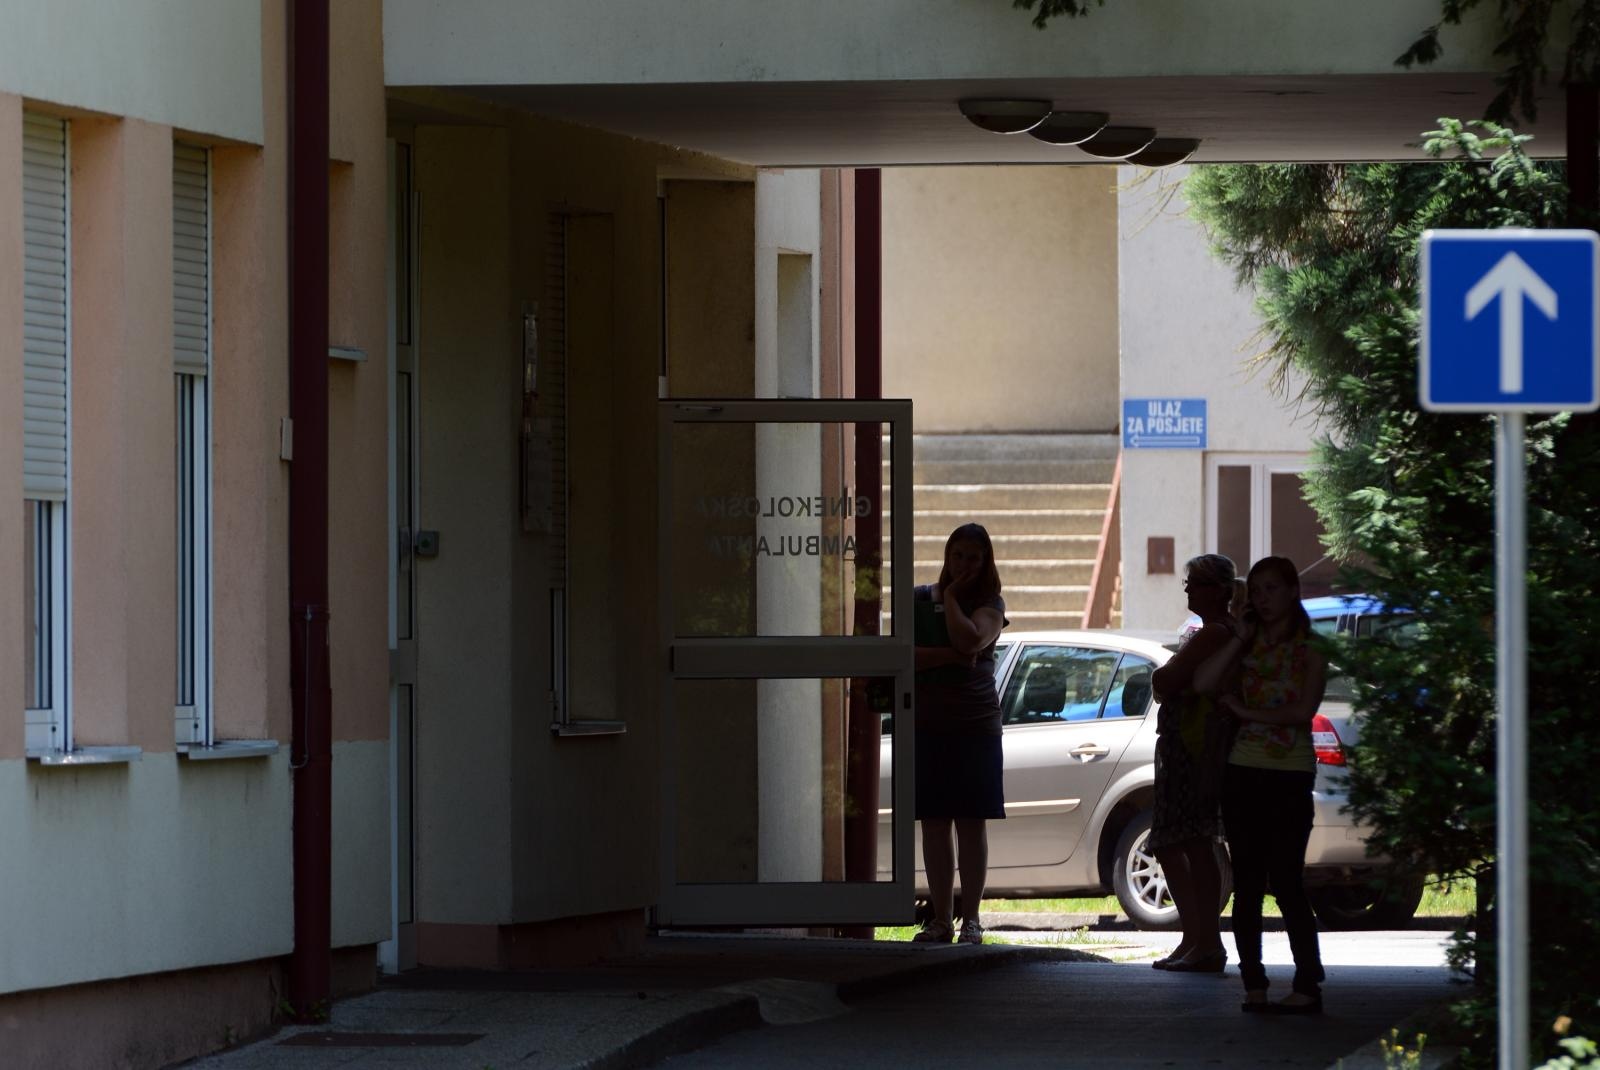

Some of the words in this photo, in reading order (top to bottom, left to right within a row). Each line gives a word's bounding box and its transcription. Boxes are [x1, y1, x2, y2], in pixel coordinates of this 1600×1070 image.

[1148, 400, 1182, 417] ULAZ
[1127, 417, 1144, 433] ZA
[1147, 417, 1203, 433] POSJETE
